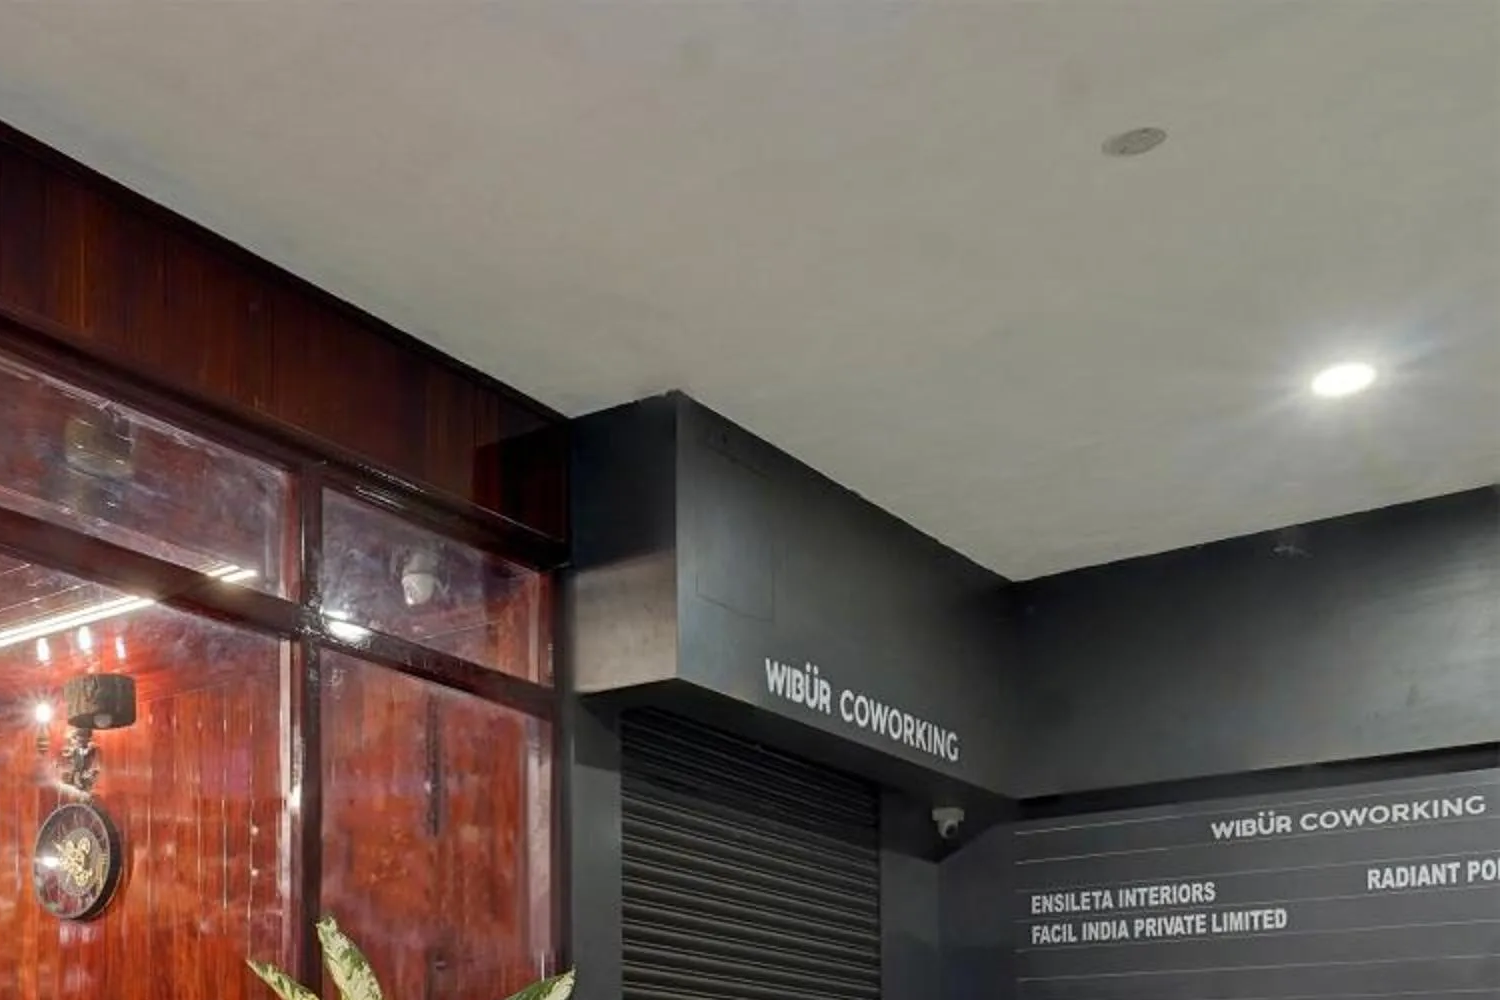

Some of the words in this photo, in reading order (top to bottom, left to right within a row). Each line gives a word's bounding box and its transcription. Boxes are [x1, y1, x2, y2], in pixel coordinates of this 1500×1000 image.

[765, 657, 831, 714] WIBÜR
[839, 689, 959, 762] COWORKING
[1211, 810, 1292, 840] WIBÜR
[1300, 796, 1486, 831] COWORKING
[1367, 861, 1460, 890] RADIANT
[1467, 857, 1500, 882] PO
[1031, 890, 1113, 914] ENSILETA
[1119, 882, 1216, 907] INTERIORS
[1031, 925, 1077, 944] FACIL
[1082, 919, 1129, 941] INDIA
[1134, 914, 1206, 938] PRIVATE
[1211, 908, 1287, 933] LIMITED
